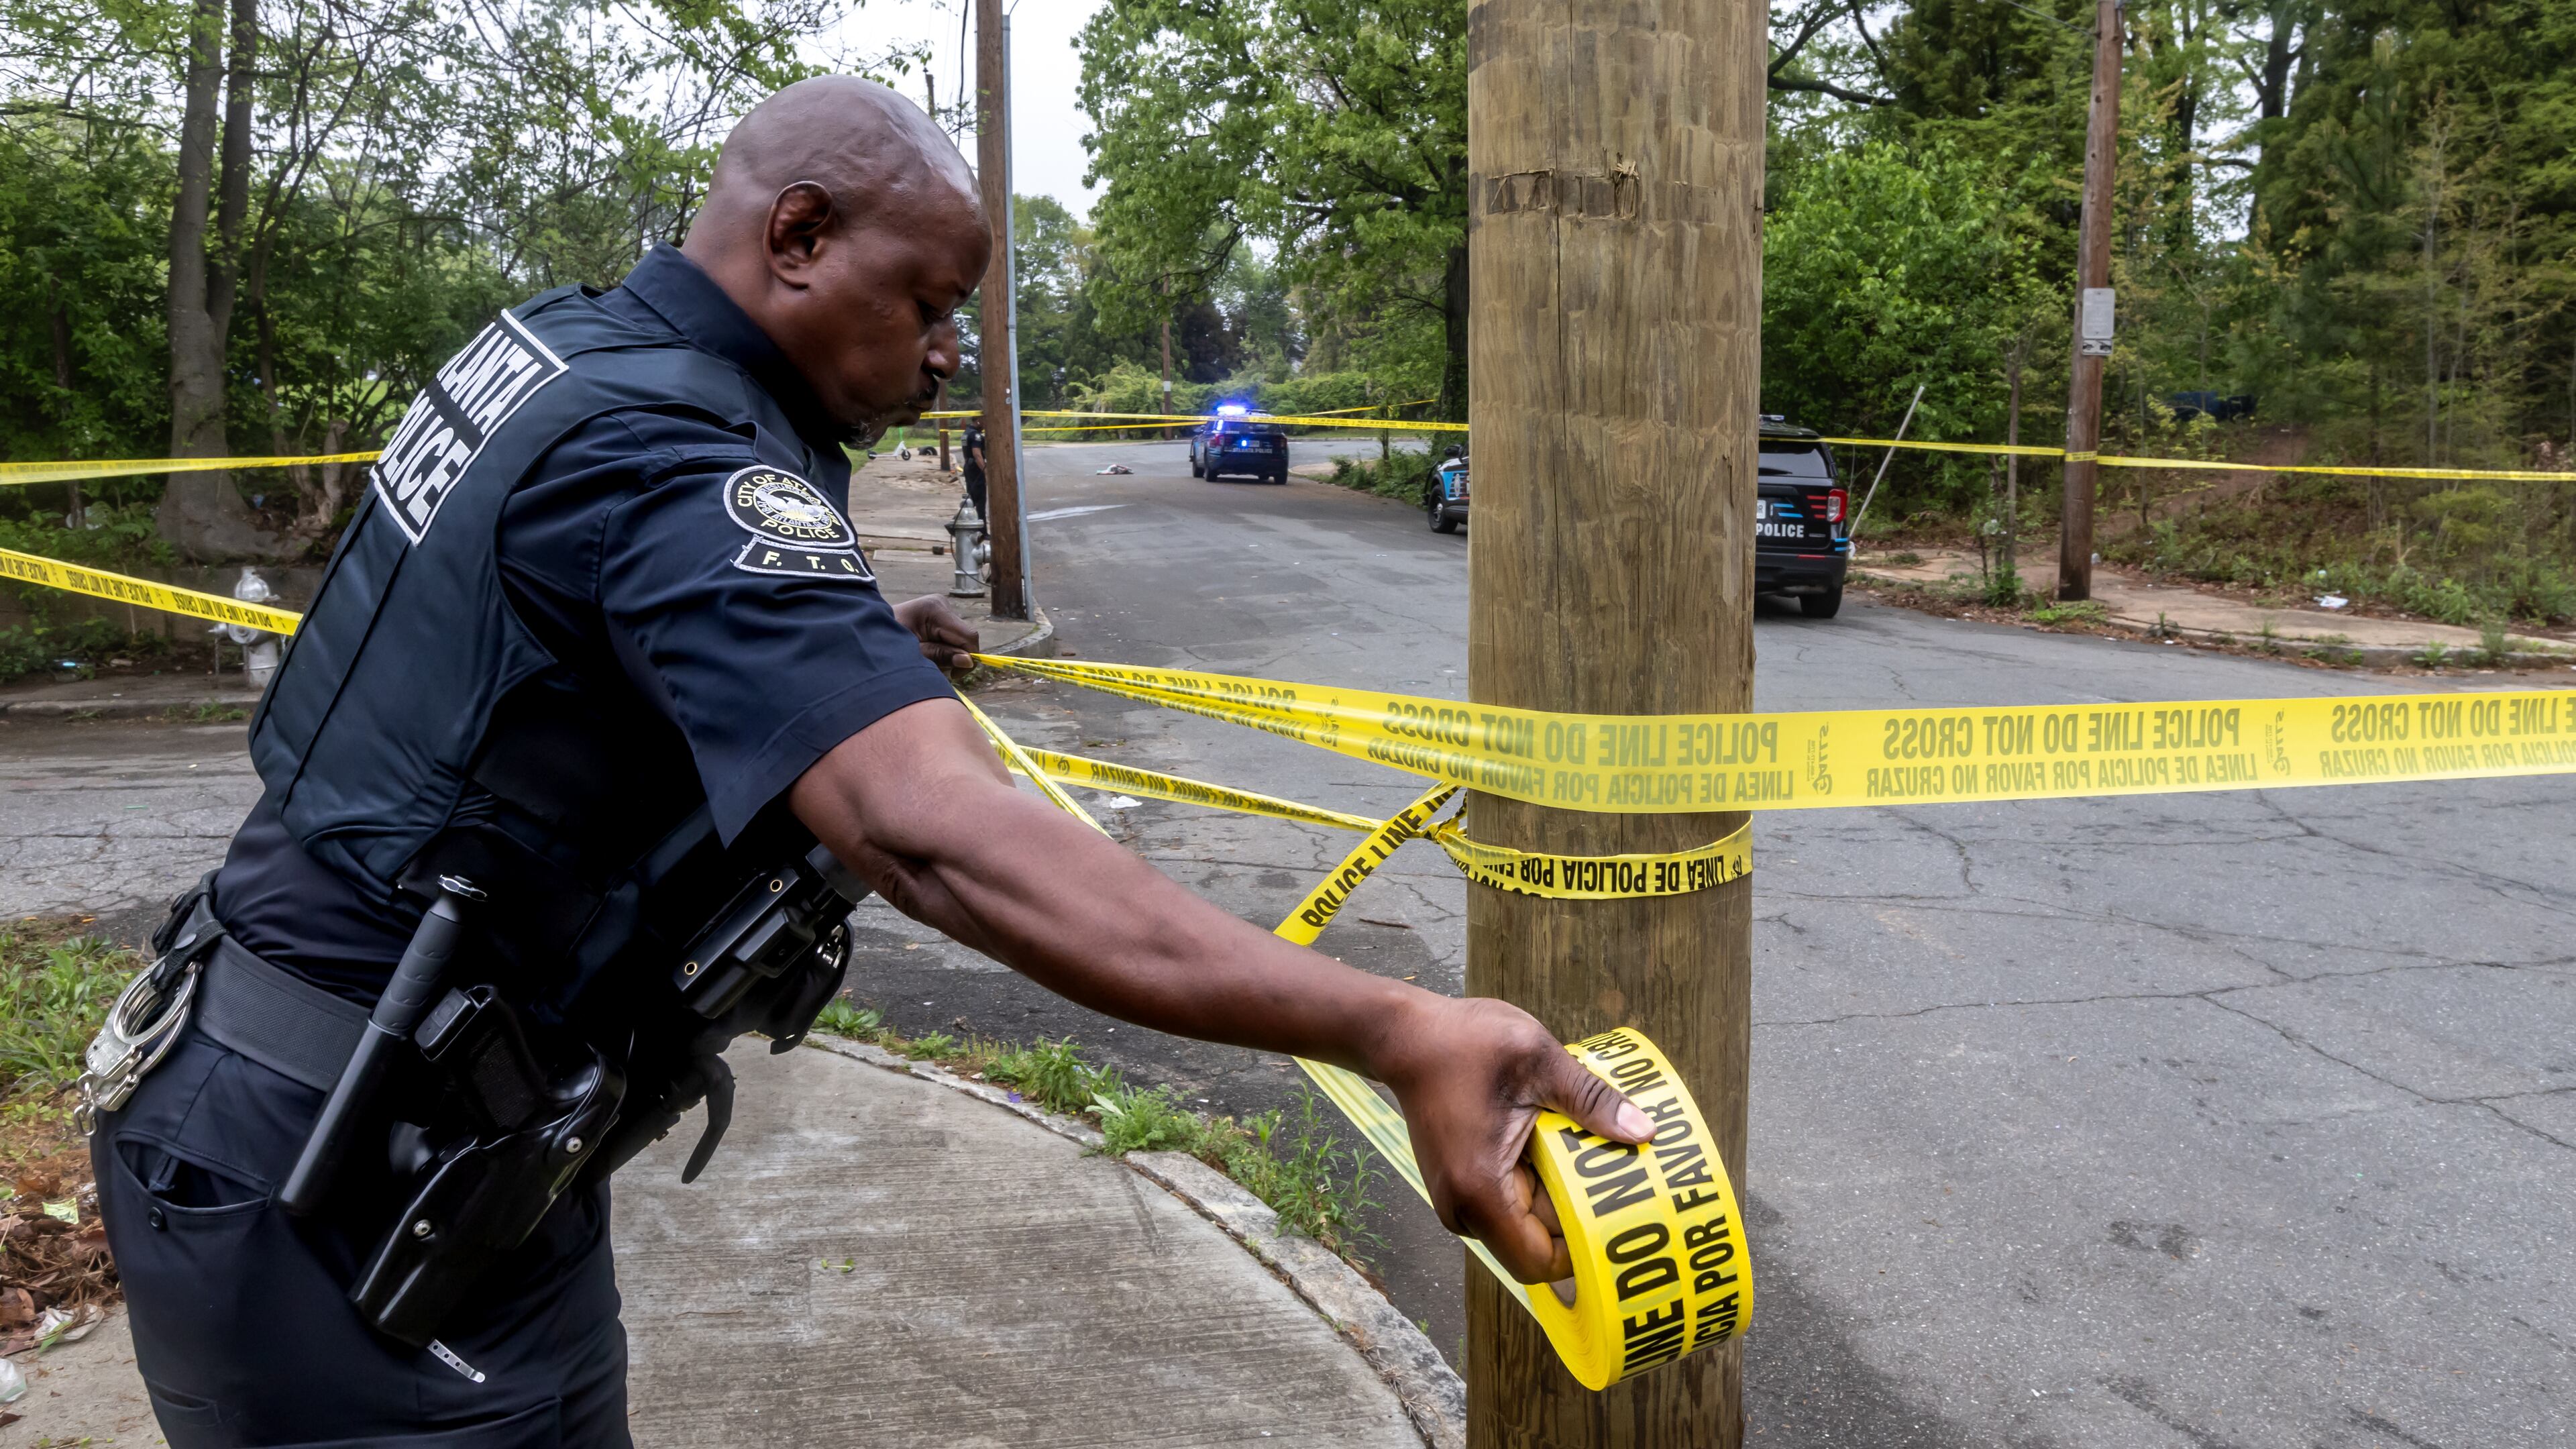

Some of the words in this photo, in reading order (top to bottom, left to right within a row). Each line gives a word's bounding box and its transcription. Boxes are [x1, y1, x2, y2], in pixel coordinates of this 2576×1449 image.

[437, 322, 543, 435] LANTA
[378, 388, 472, 526] OLICE
[737, 481, 754, 507] CITY
[753, 474, 775, 484] OF
[761, 519, 840, 539] POLICE
[1756, 523, 1805, 538] POLICE
[762, 551, 782, 566] F.
[806, 556, 826, 570] T.
[841, 559, 859, 574] O.
[1300, 856, 1375, 928] POLICE
[1369, 808, 1422, 860] LINE
[1520, 857, 1554, 889] POR
[1562, 859, 1648, 893] POLICIA
[1655, 861, 1680, 893] DE
[1686, 855, 1725, 891] LINEA
[1610, 1058, 1670, 1098] NO
[1641, 1096, 1720, 1214] FAVOR
[1605, 1222, 1680, 1303] DO
[1684, 1213, 1738, 1295] POR
